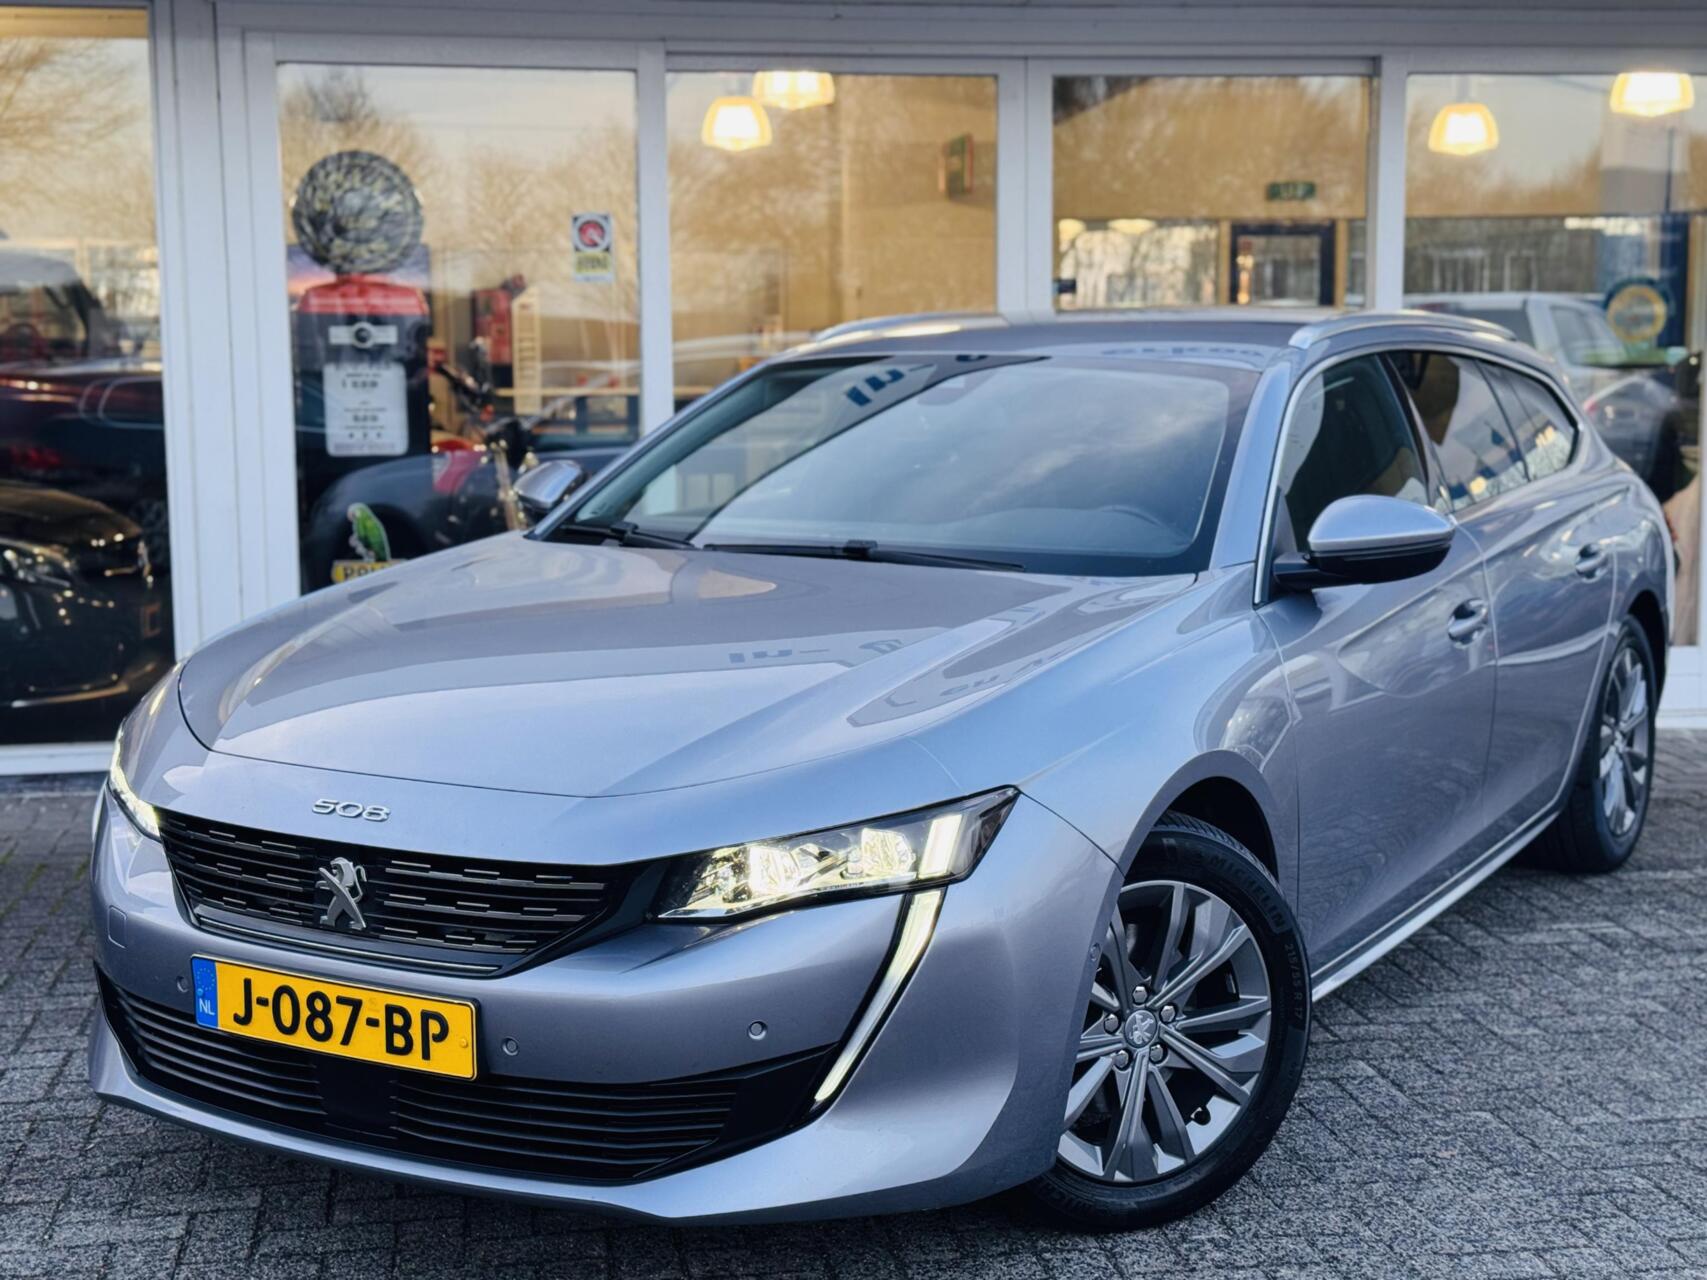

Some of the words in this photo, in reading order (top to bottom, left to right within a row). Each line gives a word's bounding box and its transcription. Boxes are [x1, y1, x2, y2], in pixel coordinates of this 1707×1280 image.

[312, 799, 390, 822] 508
[1209, 854, 1286, 927] MICHELIN
[198, 998, 215, 1016] NL
[233, 978, 449, 1060] J-087-BP
